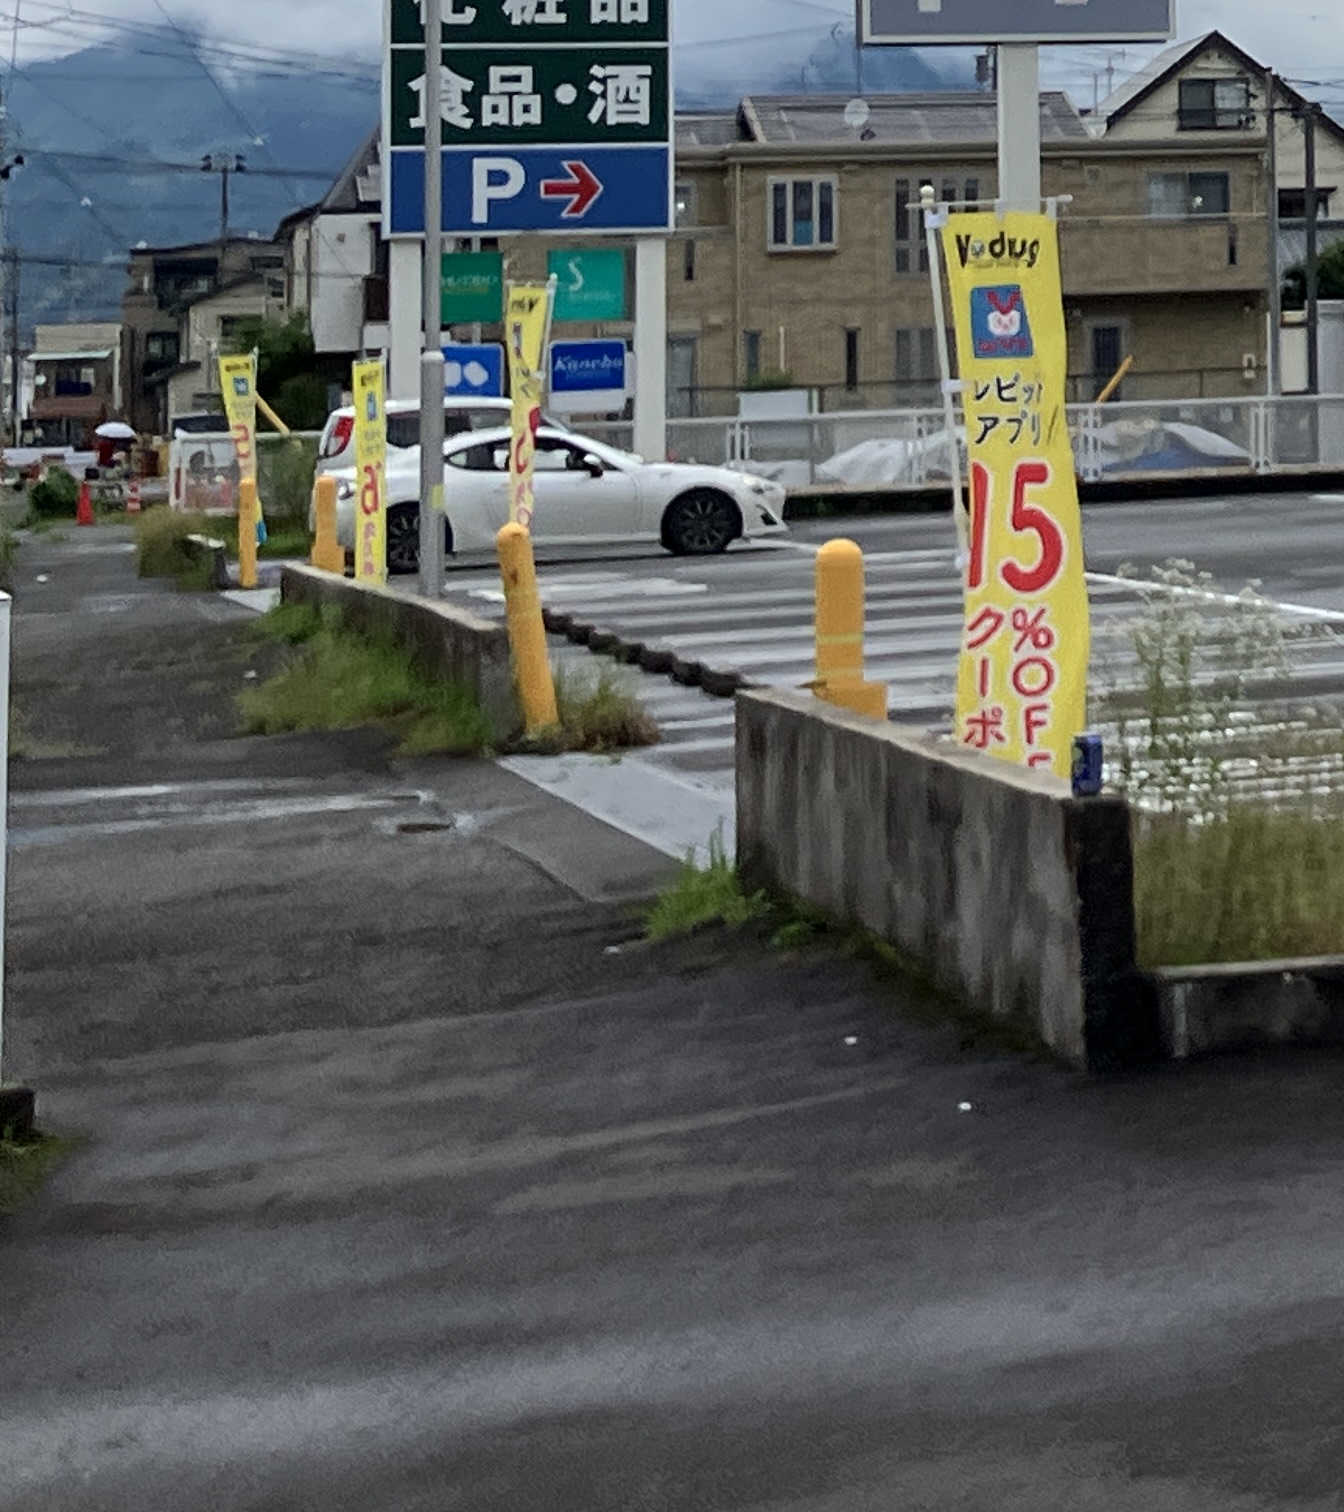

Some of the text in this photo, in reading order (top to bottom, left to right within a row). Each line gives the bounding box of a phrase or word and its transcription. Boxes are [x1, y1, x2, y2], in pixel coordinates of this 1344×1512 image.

[408, 64, 652, 129] 食品・酒
[472, 157, 525, 224] P
[969, 462, 1064, 593] 15
